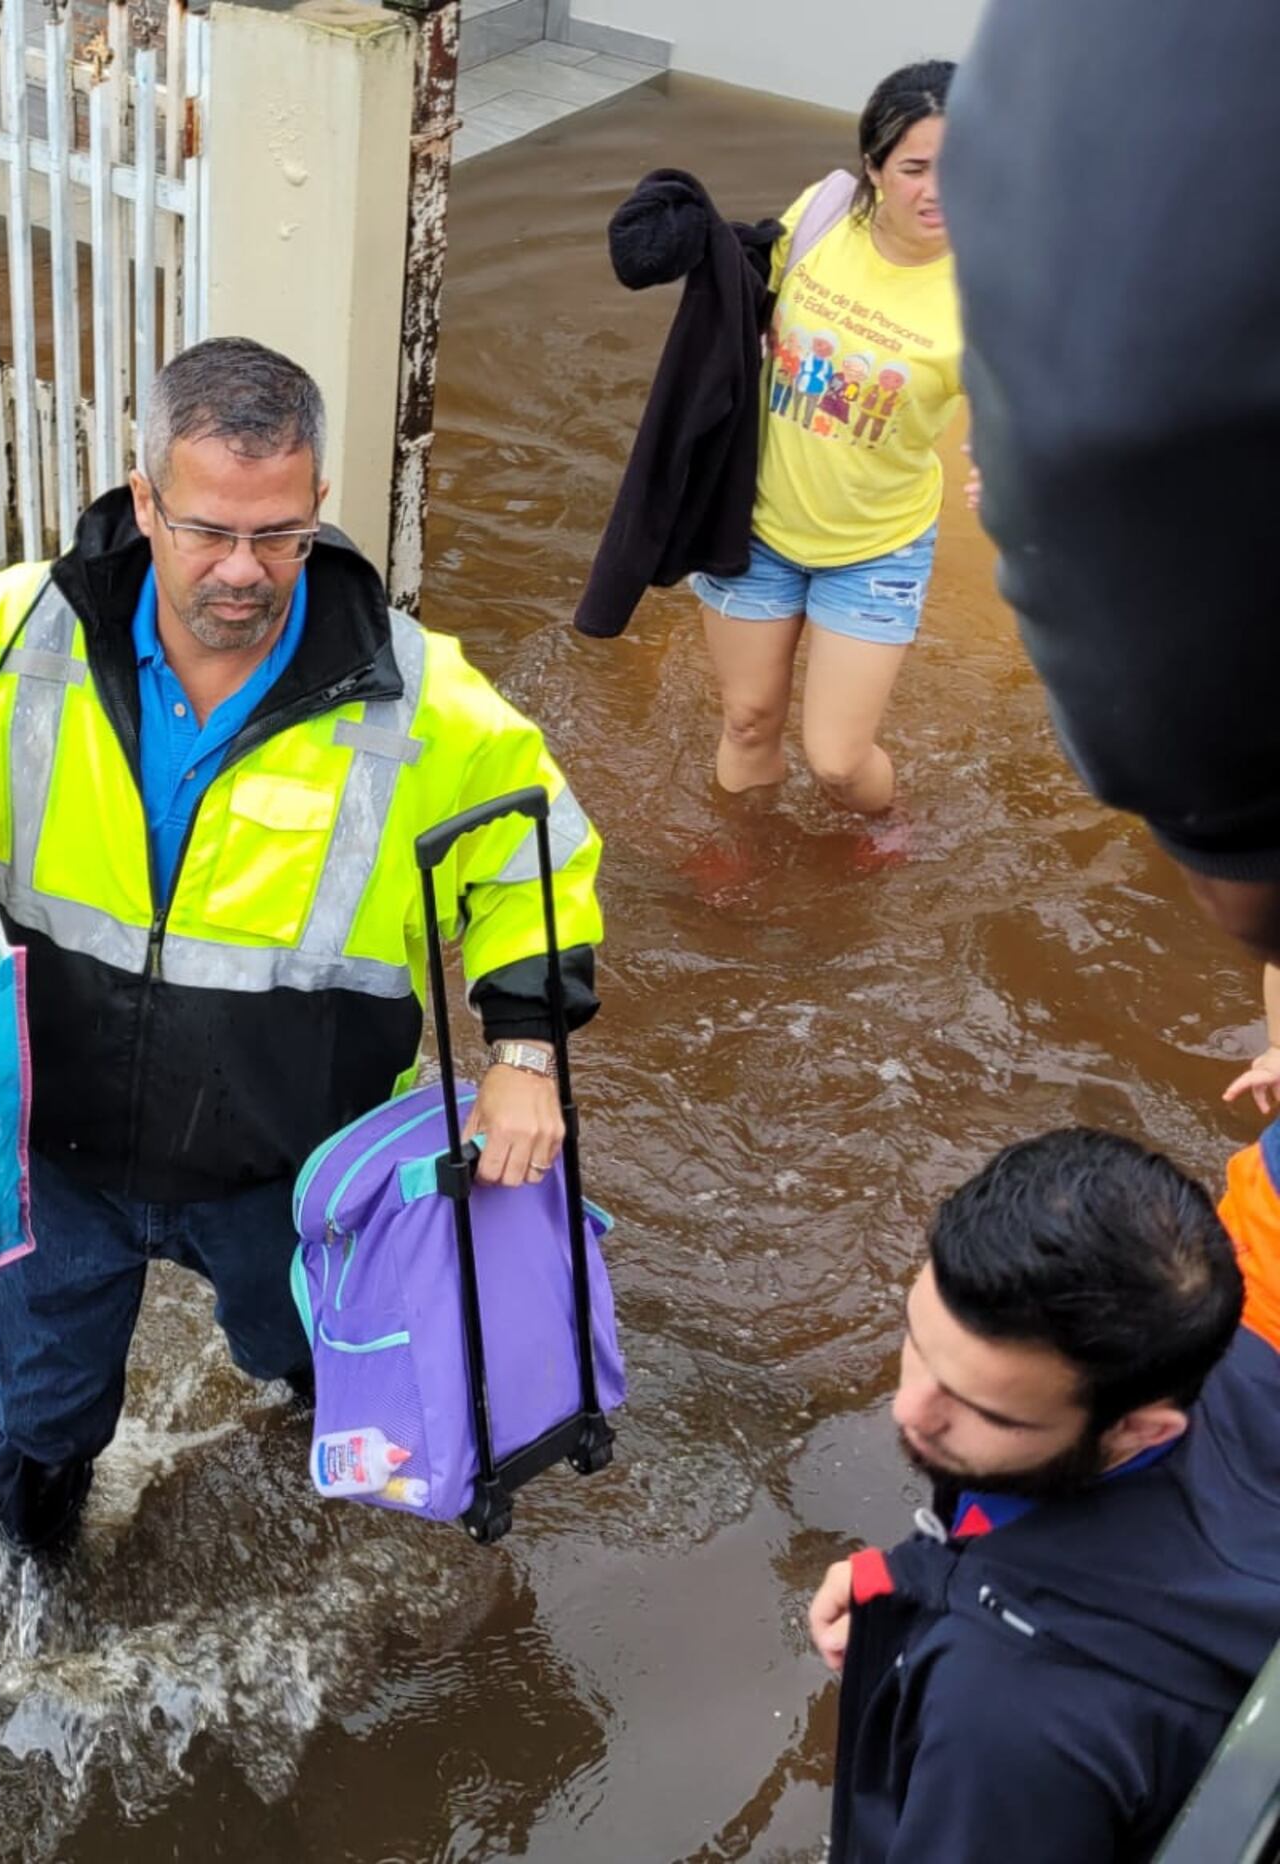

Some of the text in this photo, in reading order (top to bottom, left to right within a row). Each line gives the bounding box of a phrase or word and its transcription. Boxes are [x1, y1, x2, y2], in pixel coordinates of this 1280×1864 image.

[803, 295, 840, 321] Edad
[837, 315, 903, 353] Avanzada
[831, 294, 850, 309] de
[869, 310, 934, 349] Personas
